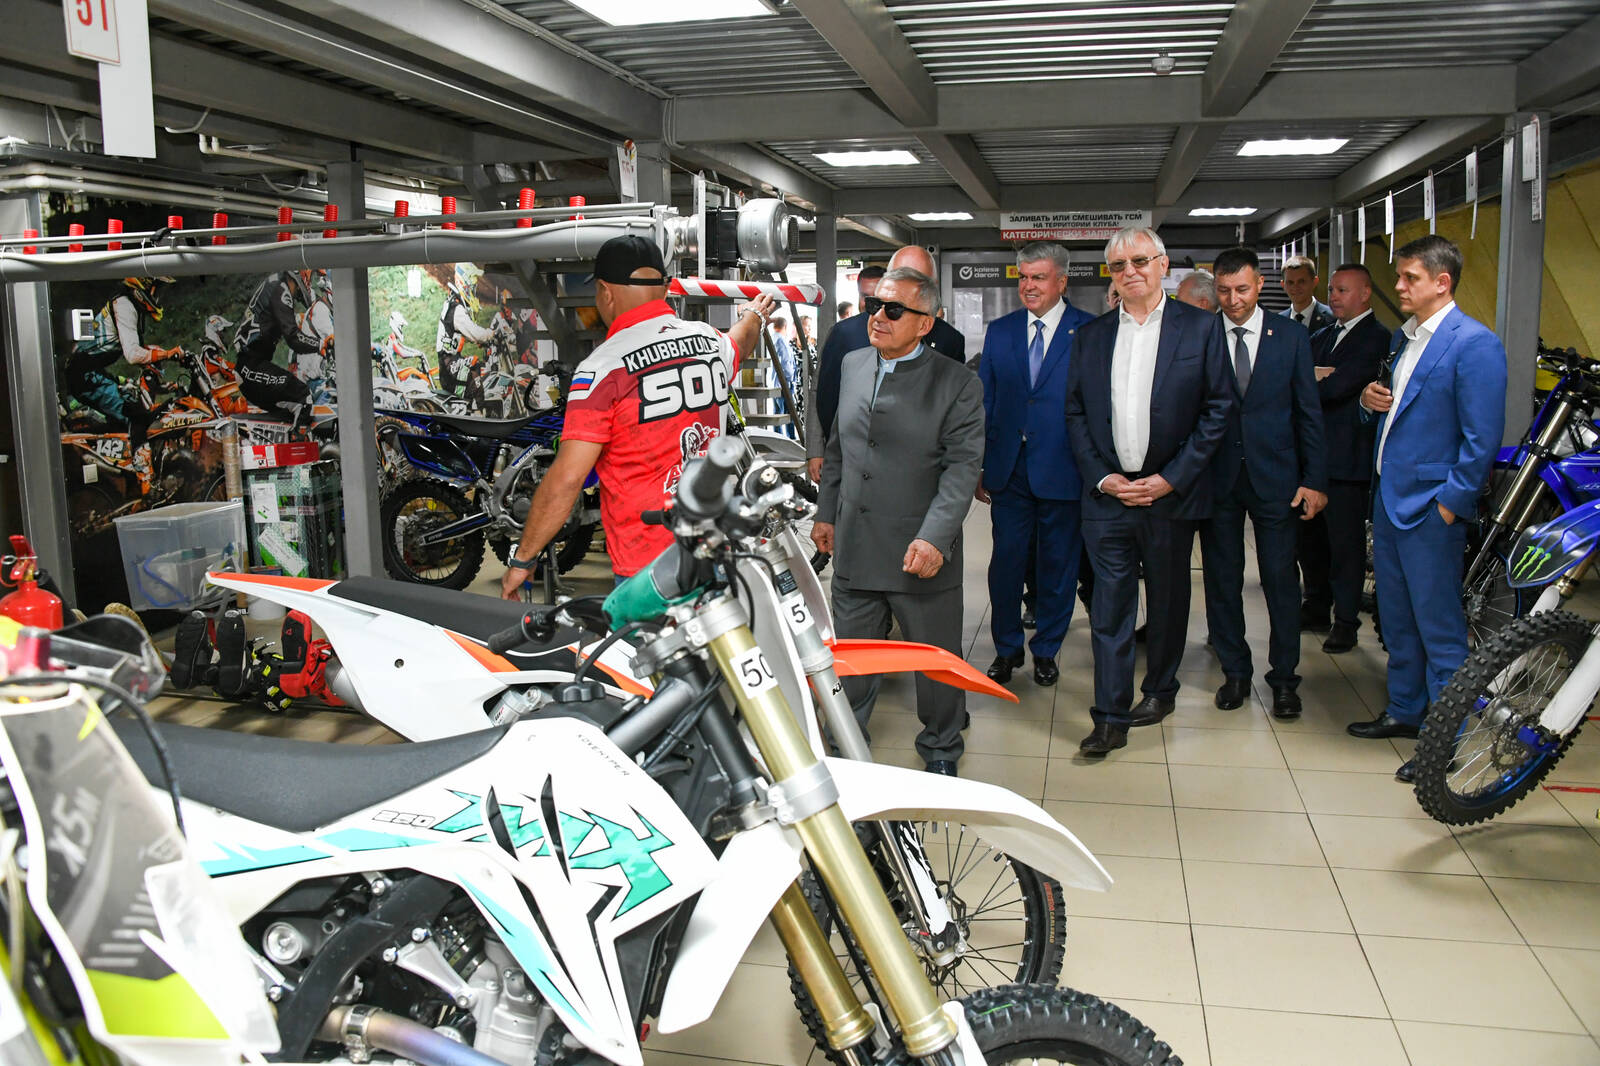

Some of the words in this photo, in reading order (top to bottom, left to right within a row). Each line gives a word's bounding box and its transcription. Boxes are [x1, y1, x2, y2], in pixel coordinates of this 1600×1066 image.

[1003, 230, 1083, 239] КАТЕГОРИЧЕСКИ
[640, 358, 729, 421] 500
[791, 603, 807, 623] 5
